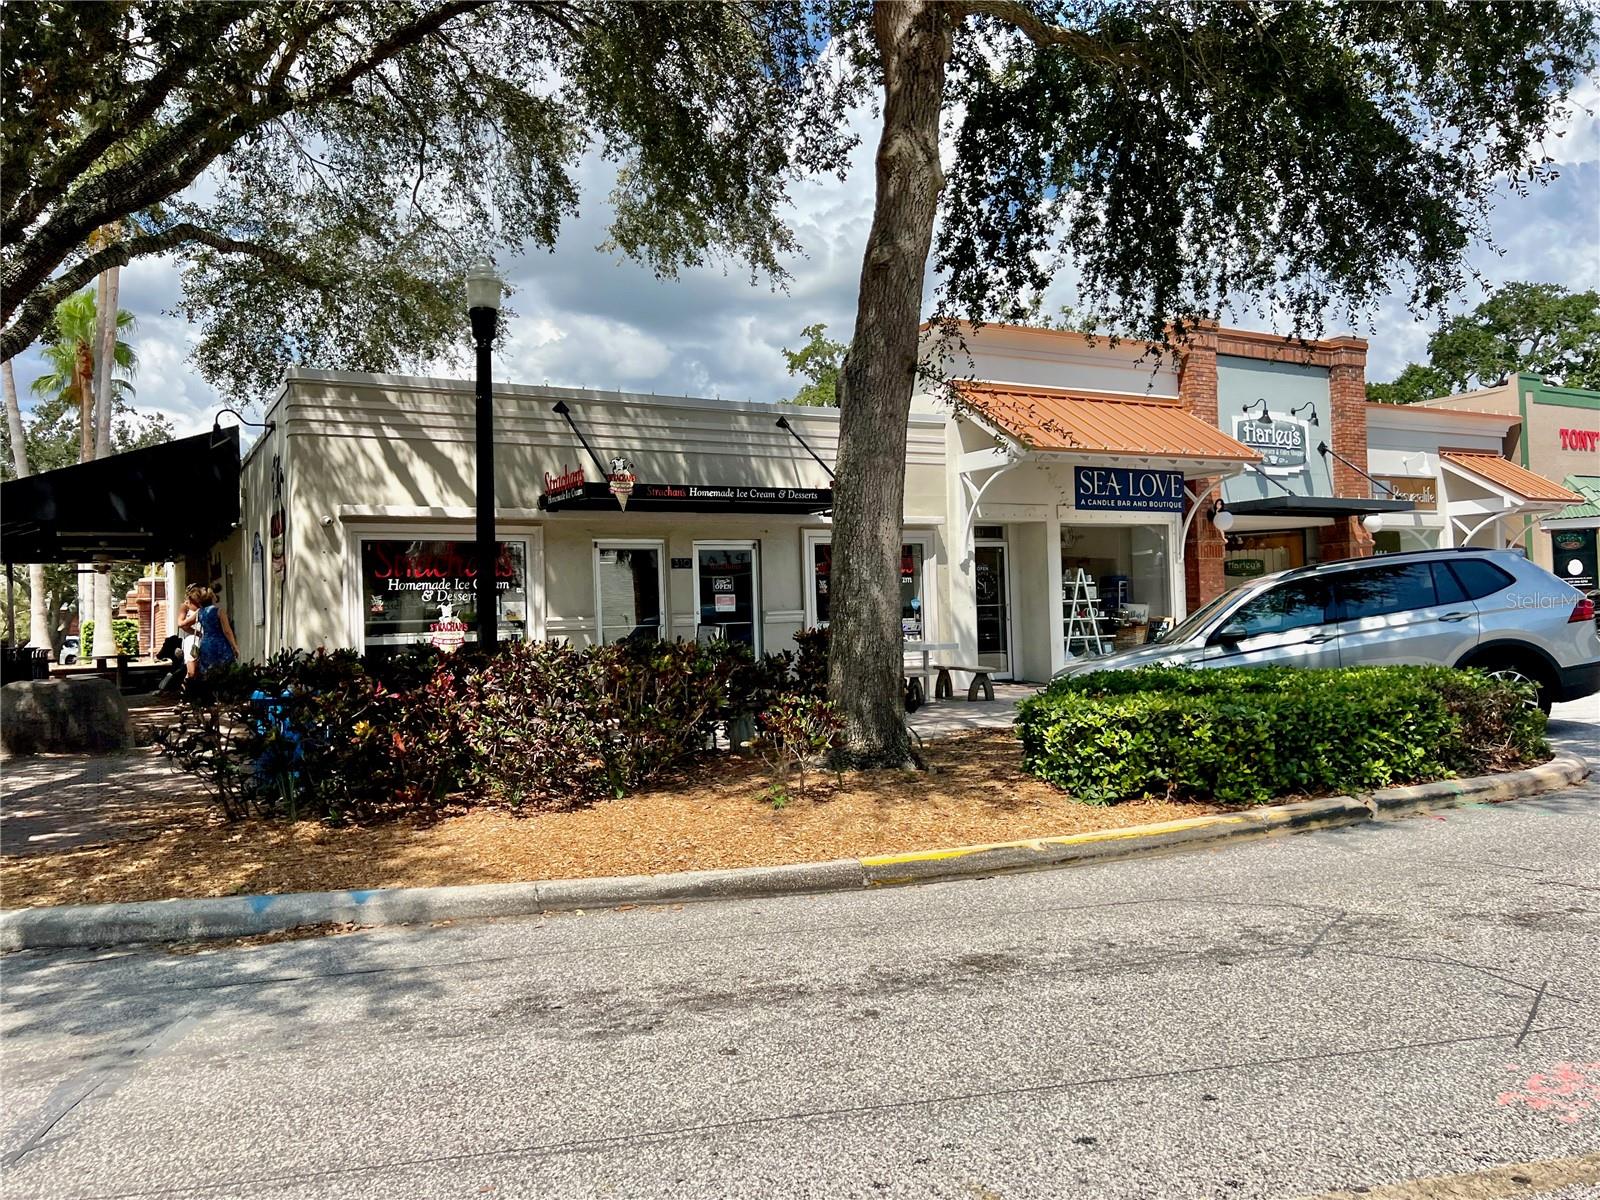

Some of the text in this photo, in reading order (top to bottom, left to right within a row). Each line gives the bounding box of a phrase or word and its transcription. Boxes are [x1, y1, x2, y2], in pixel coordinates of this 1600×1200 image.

[1243, 422, 1301, 449] Harley's
[1080, 470, 1183, 498] SEA LOVE
[689, 487, 735, 498] Homemade
[736, 489, 748, 498] Ice
[749, 489, 776, 499] Cream
[778, 489, 786, 498] &
[788, 490, 818, 500] Desserts
[674, 559, 691, 568] 310
[388, 578, 451, 591] Homemade
[455, 579, 470, 590] Ice
[422, 590, 478, 602] & Dessert
